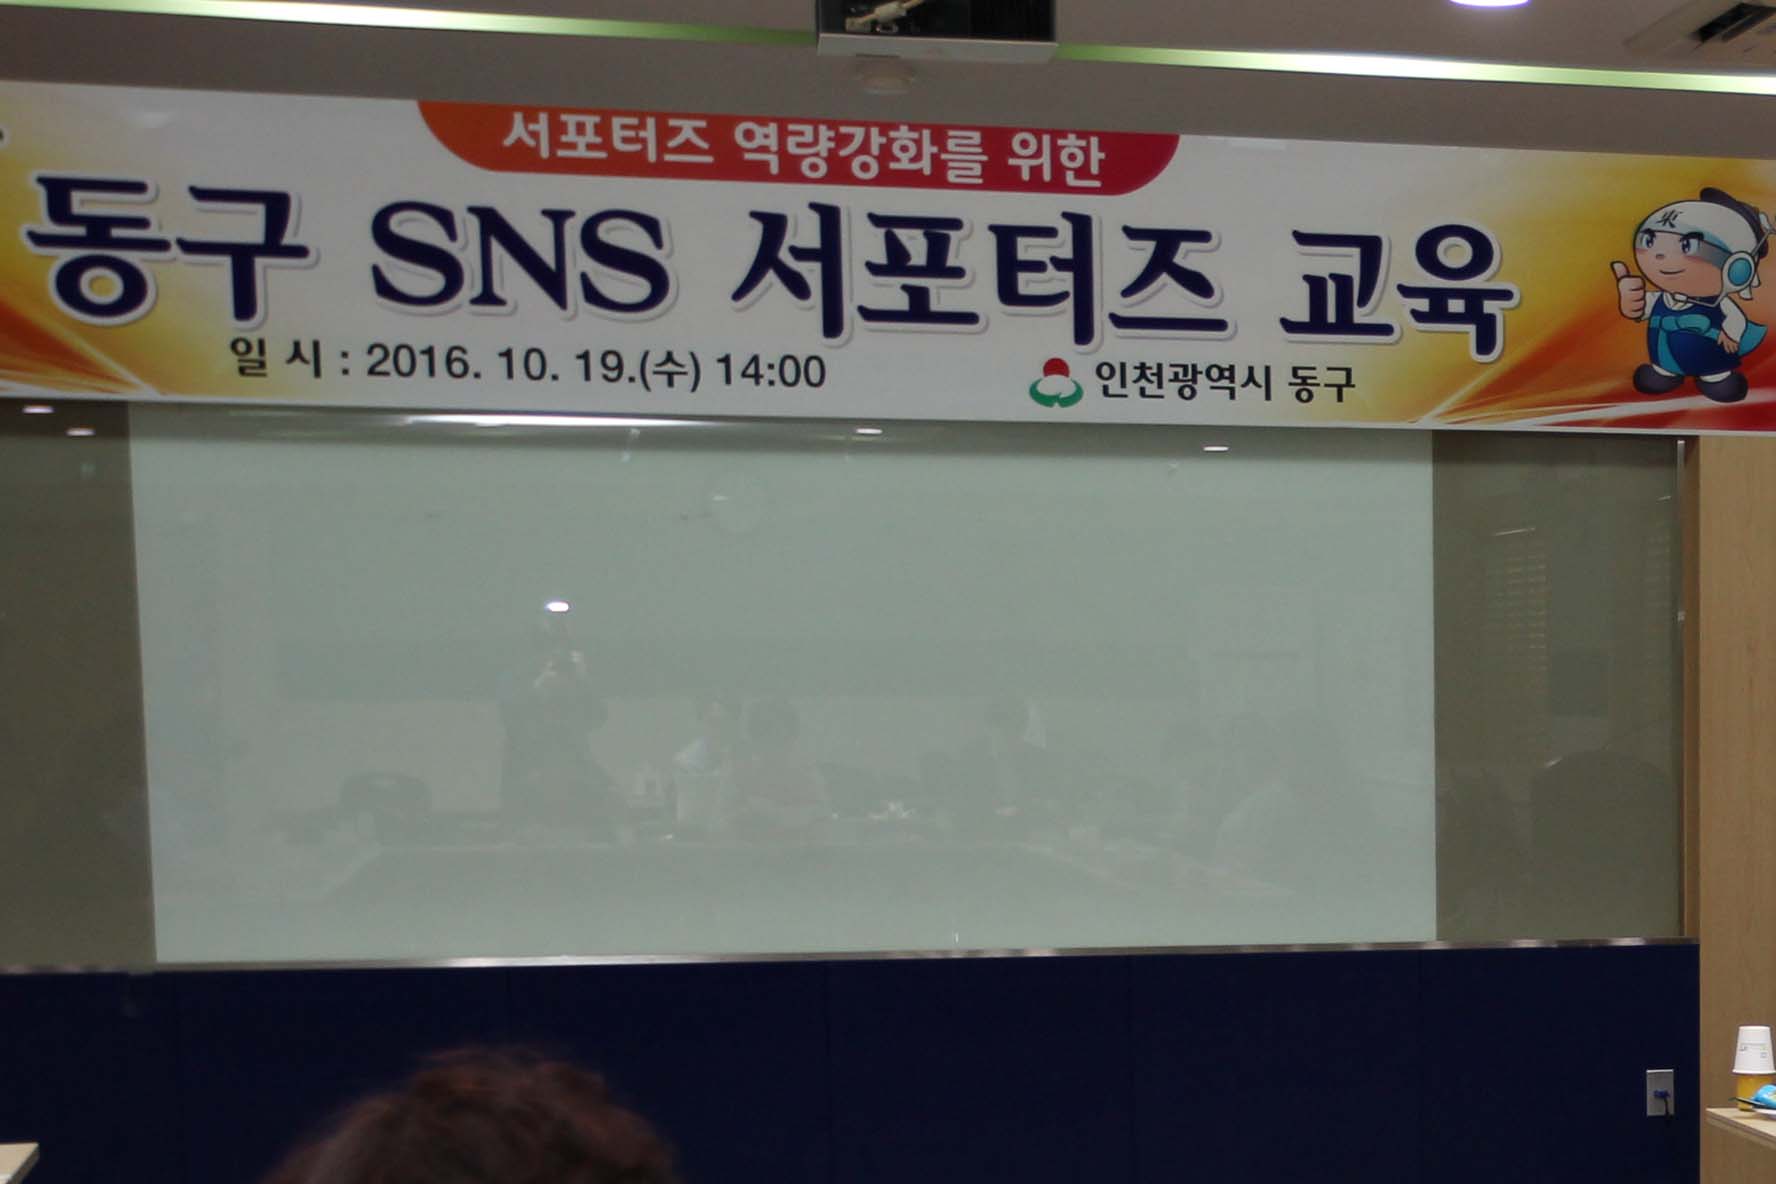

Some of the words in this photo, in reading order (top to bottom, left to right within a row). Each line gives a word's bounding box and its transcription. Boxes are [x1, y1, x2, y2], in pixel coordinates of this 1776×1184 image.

[502, 110, 714, 165] 서포터즈
[733, 120, 989, 185] 역량강화를
[1007, 131, 1105, 188] 위한
[26, 175, 310, 322] 동구
[370, 201, 671, 313] SNS
[731, 202, 1229, 347] 서포터즈
[1279, 224, 1515, 357] 교육
[366, 342, 481, 379] 2016.
[498, 347, 560, 381] 10.
[575, 349, 702, 393] 19.(수)
[716, 353, 827, 388] 14:00
[1095, 361, 1272, 402] 인천광역시
[1288, 364, 1356, 404] 동구
